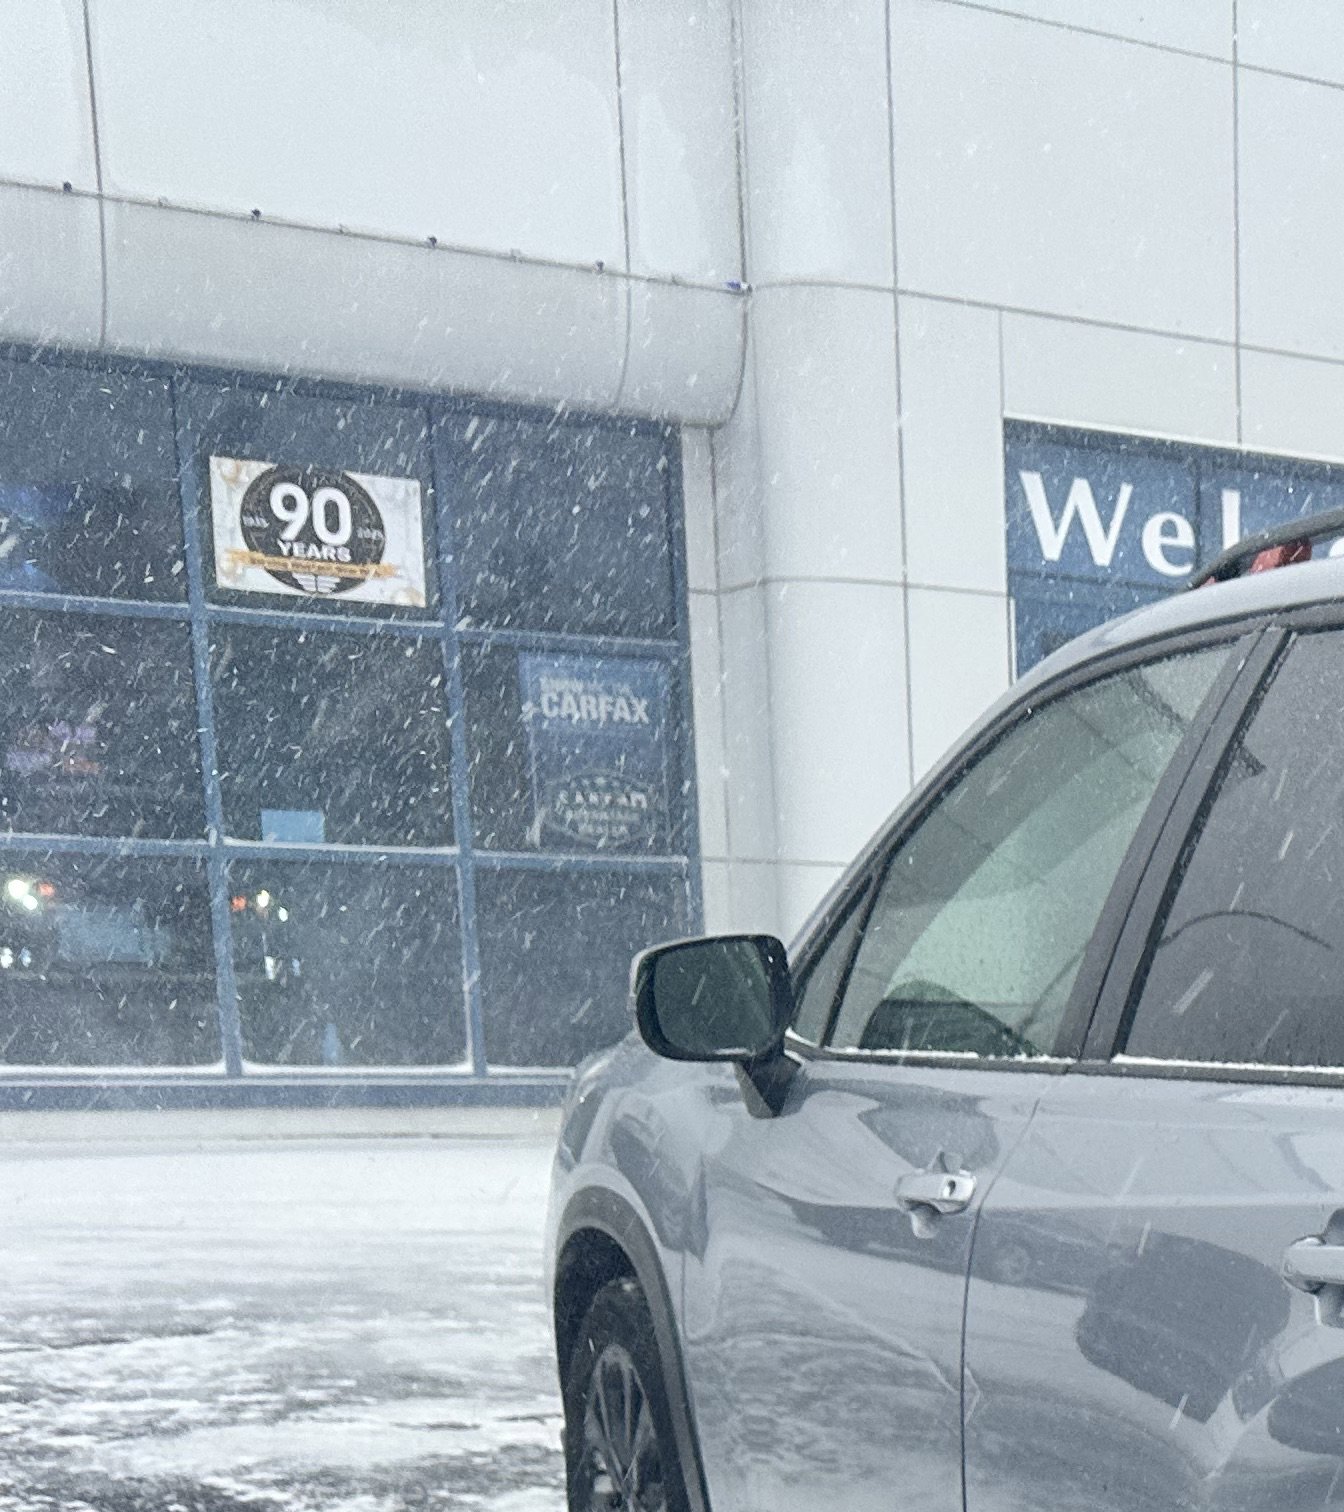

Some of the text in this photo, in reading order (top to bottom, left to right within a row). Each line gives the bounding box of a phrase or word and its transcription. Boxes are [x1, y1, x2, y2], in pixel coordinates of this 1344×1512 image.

[269, 482, 352, 546] 90
[276, 540, 352, 562] YEARS
[541, 691, 650, 725] CARFAX
